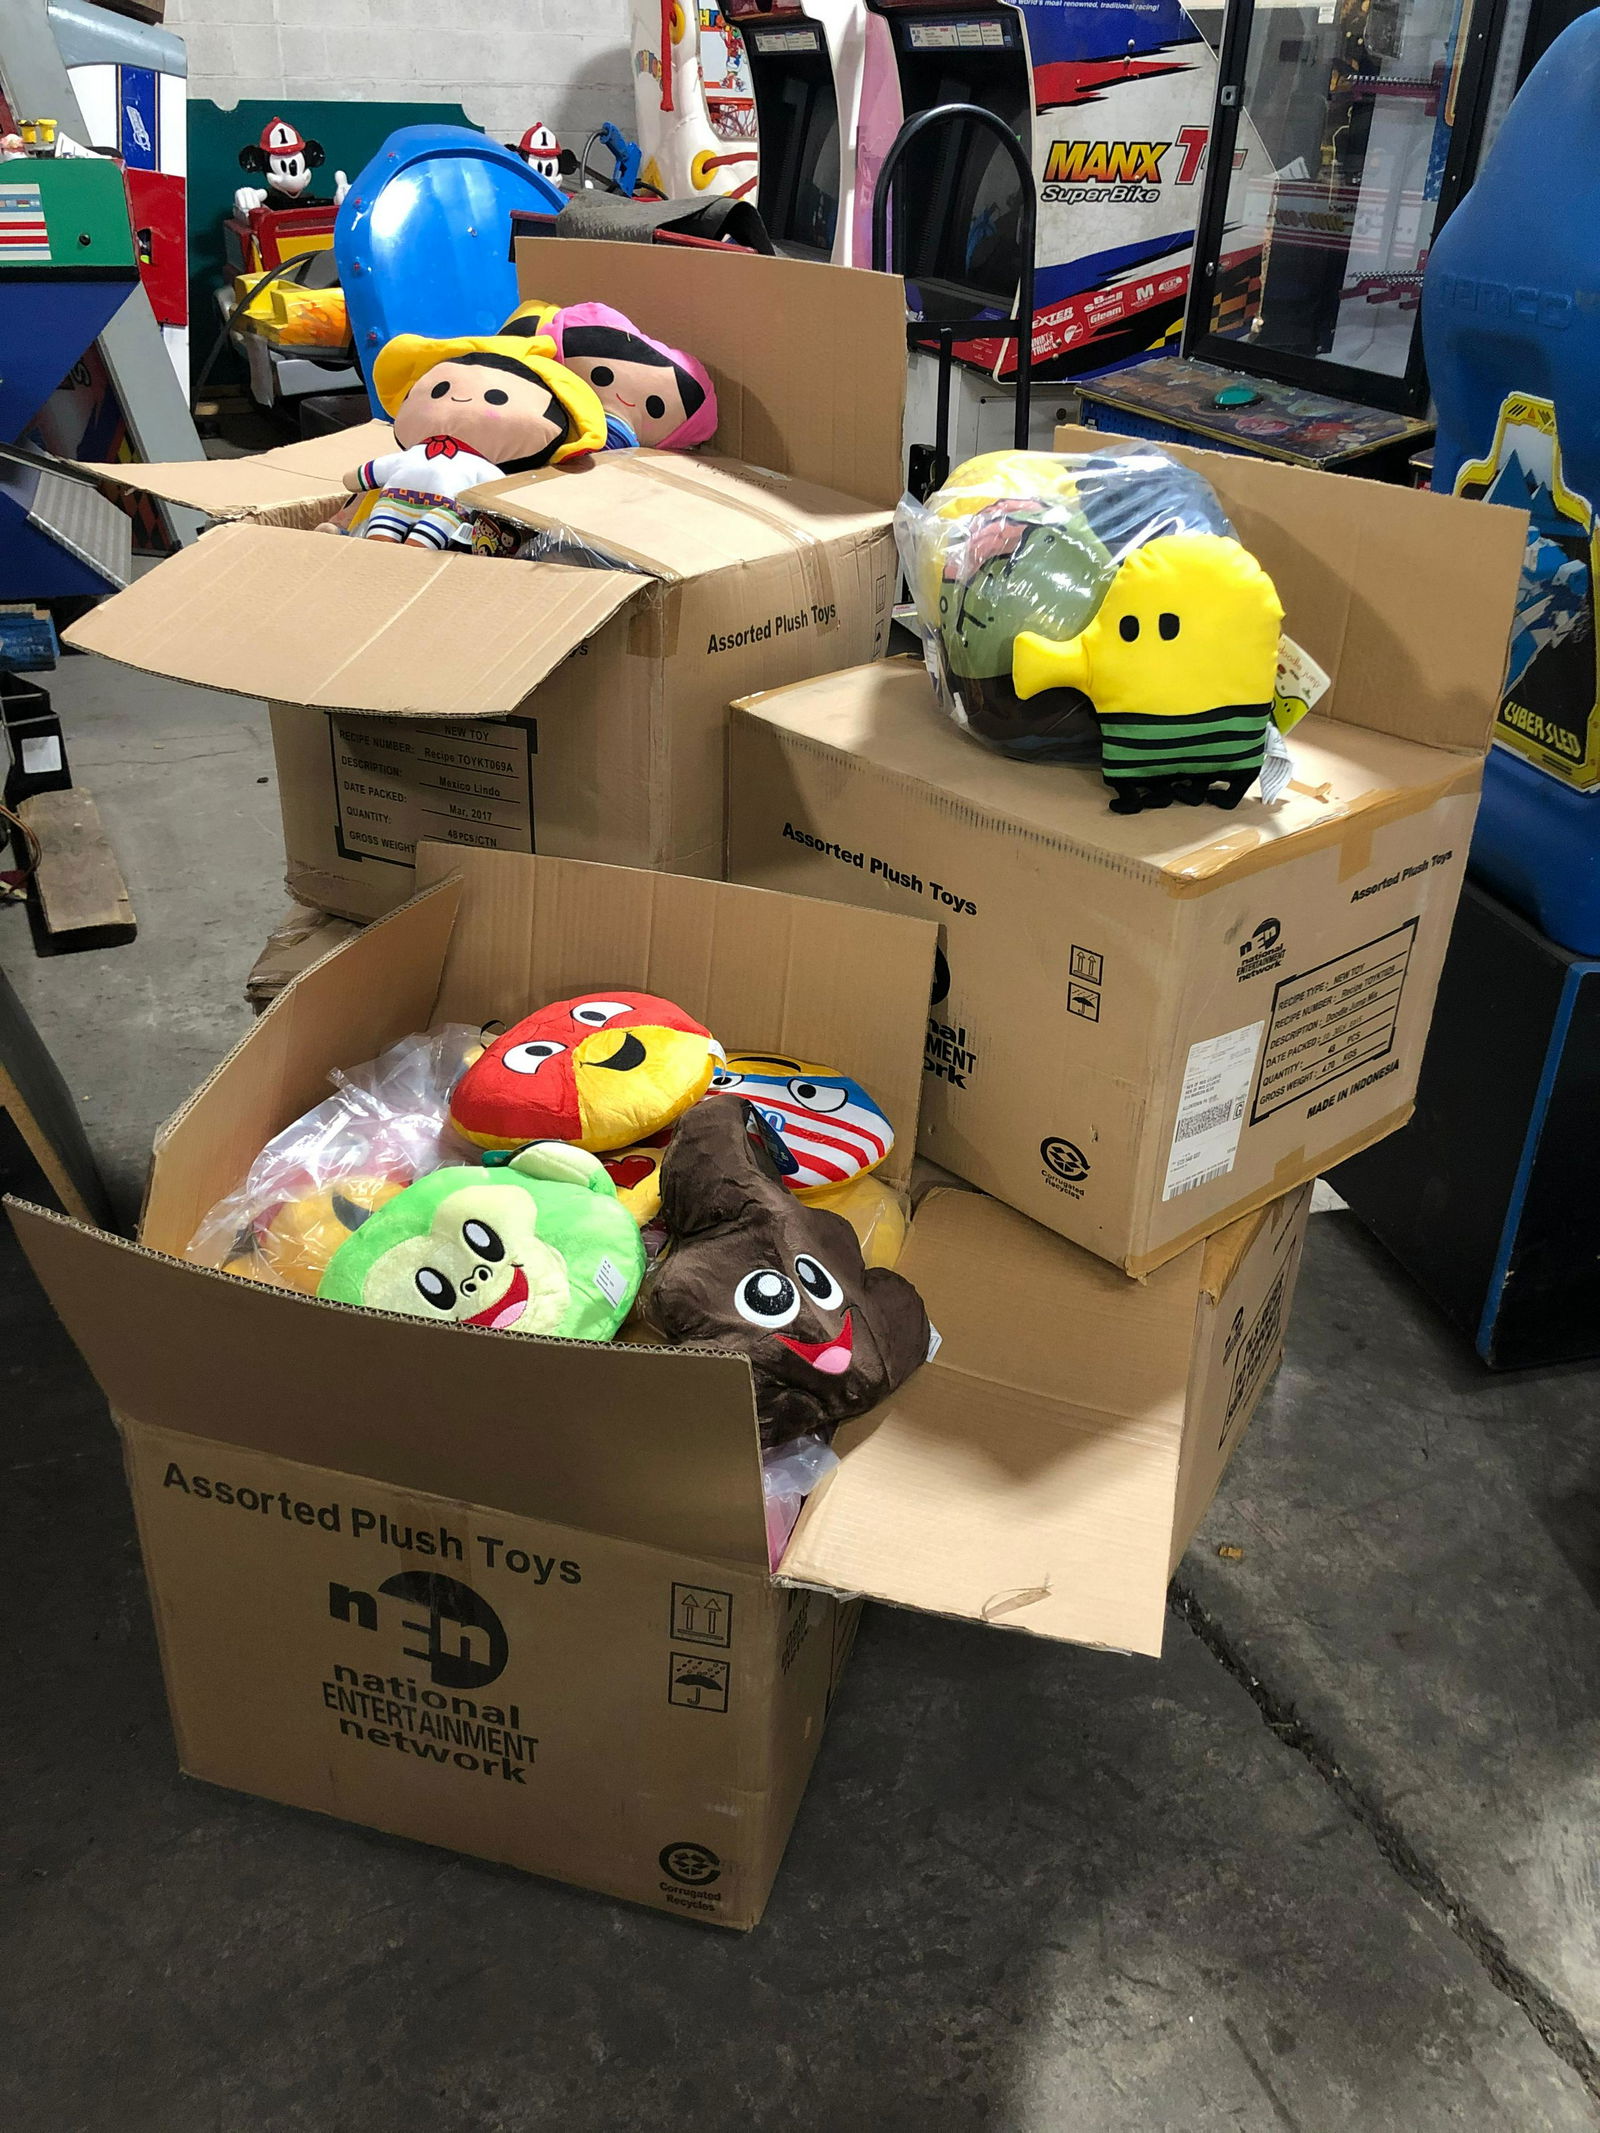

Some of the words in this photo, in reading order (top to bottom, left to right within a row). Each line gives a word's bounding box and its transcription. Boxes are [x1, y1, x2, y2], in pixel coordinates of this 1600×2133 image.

[1064, 1, 1098, 9] renowned,
[1100, 2, 1135, 10] traditional
[278, 127, 289, 145] 1
[541, 131, 548, 146] 1
[1043, 140, 1172, 183] MANX
[707, 620, 771, 654] Assorted
[775, 609, 808, 636] Plush
[811, 602, 836, 626] Toys
[444, 725, 468, 738] NEW
[470, 727, 489, 742] TOY
[1504, 701, 1545, 740] CYBER
[1545, 722, 1581, 758] SLED
[339, 729, 370, 746] RECIPE
[373, 736, 415, 754] NUMBER:
[424, 747, 455, 763] Recipe
[341, 755, 402, 777] DESCRIPTION:
[439, 775, 471, 792] Mexico
[473, 783, 500, 797] Lindo
[343, 780, 366, 795] DATE
[368, 786, 407, 803] PACKED:
[471, 808, 492, 822] 2017
[346, 806, 392, 825] QUANTITY:
[349, 830, 379, 846] GROSS
[782, 822, 864, 869] Assorted
[870, 856, 923, 895] Plush
[929, 881, 978, 917] Toys
[1350, 872, 1401, 904] Assorted
[1401, 860, 1429, 881] Plush
[1431, 850, 1452, 867] Toys
[1236, 949, 1286, 976] ENTERTAINMENT
[1241, 943, 1284, 966] national
[1238, 960, 1282, 982] network
[1278, 993, 1305, 1011] RECIPE
[1333, 972, 1350, 985] NEW
[1351, 963, 1366, 978] TOY
[1274, 1010, 1302, 1031] RECIPE
[1266, 1054, 1286, 1069] DATE
[1260, 1085, 1286, 1105] GROSS
[1307, 1094, 1336, 1119] MADE
[1337, 1088, 1349, 1103] IN
[1349, 1059, 1399, 1096] INDONESIA
[1041, 1169, 1085, 1197] Corrugated
[1045, 1178, 1080, 1200] Recycles
[163, 1461, 341, 1533] Assorted
[351, 1507, 464, 1561] Plush
[477, 1535, 582, 1587] Toys
[333, 1663, 520, 1731] national
[322, 1682, 539, 1765] ENTERTAINMENT
[339, 1716, 526, 1785] network
[660, 1881, 721, 1901] Corrugated
[666, 1894, 716, 1911] Recycles
